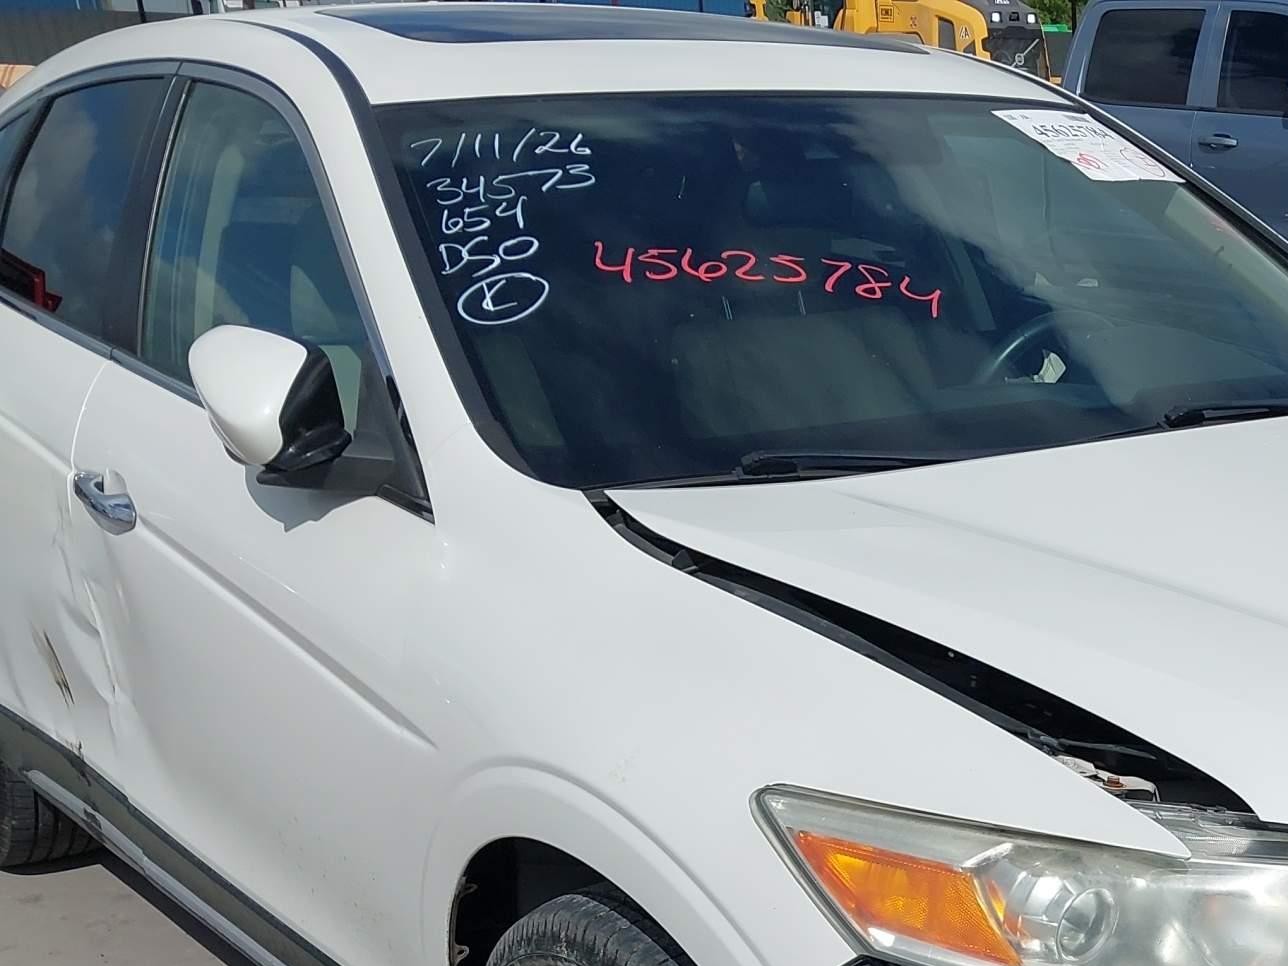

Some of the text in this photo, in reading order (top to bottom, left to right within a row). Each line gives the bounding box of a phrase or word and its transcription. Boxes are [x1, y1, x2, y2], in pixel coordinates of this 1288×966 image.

[411, 128, 592, 168] 7/11/26
[426, 164, 596, 205] 34573
[442, 196, 528, 234] 654
[593, 240, 943, 320] 45625784
